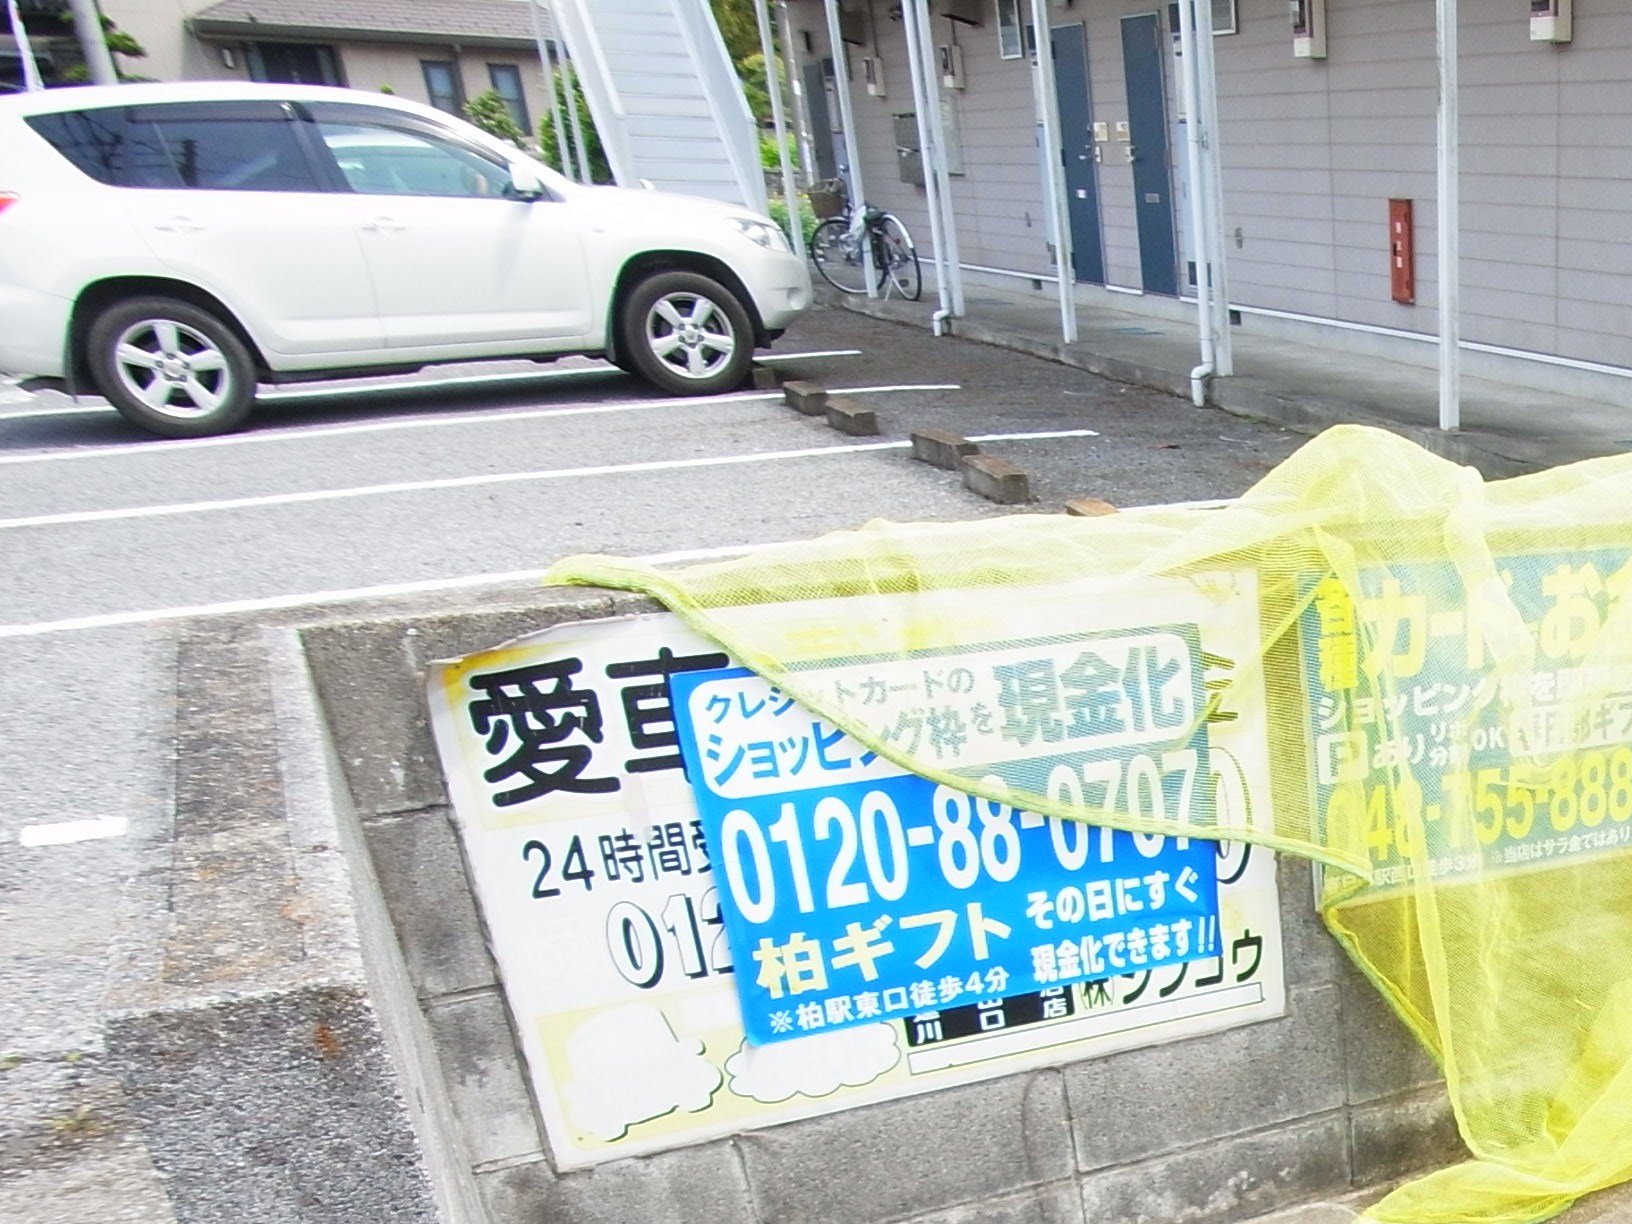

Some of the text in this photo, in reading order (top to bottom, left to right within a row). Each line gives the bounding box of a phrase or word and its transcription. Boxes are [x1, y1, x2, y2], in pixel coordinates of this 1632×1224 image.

[705, 667, 975, 726] クレジトカードの
[992, 645, 1186, 747] 現金化
[721, 750, 1198, 925] 0120-88-0707
[1026, 866, 1199, 929] その日にすぐ
[753, 902, 1012, 999] 柏ギフト
[768, 967, 1011, 1035] ※柏駅東口徒歩4分
